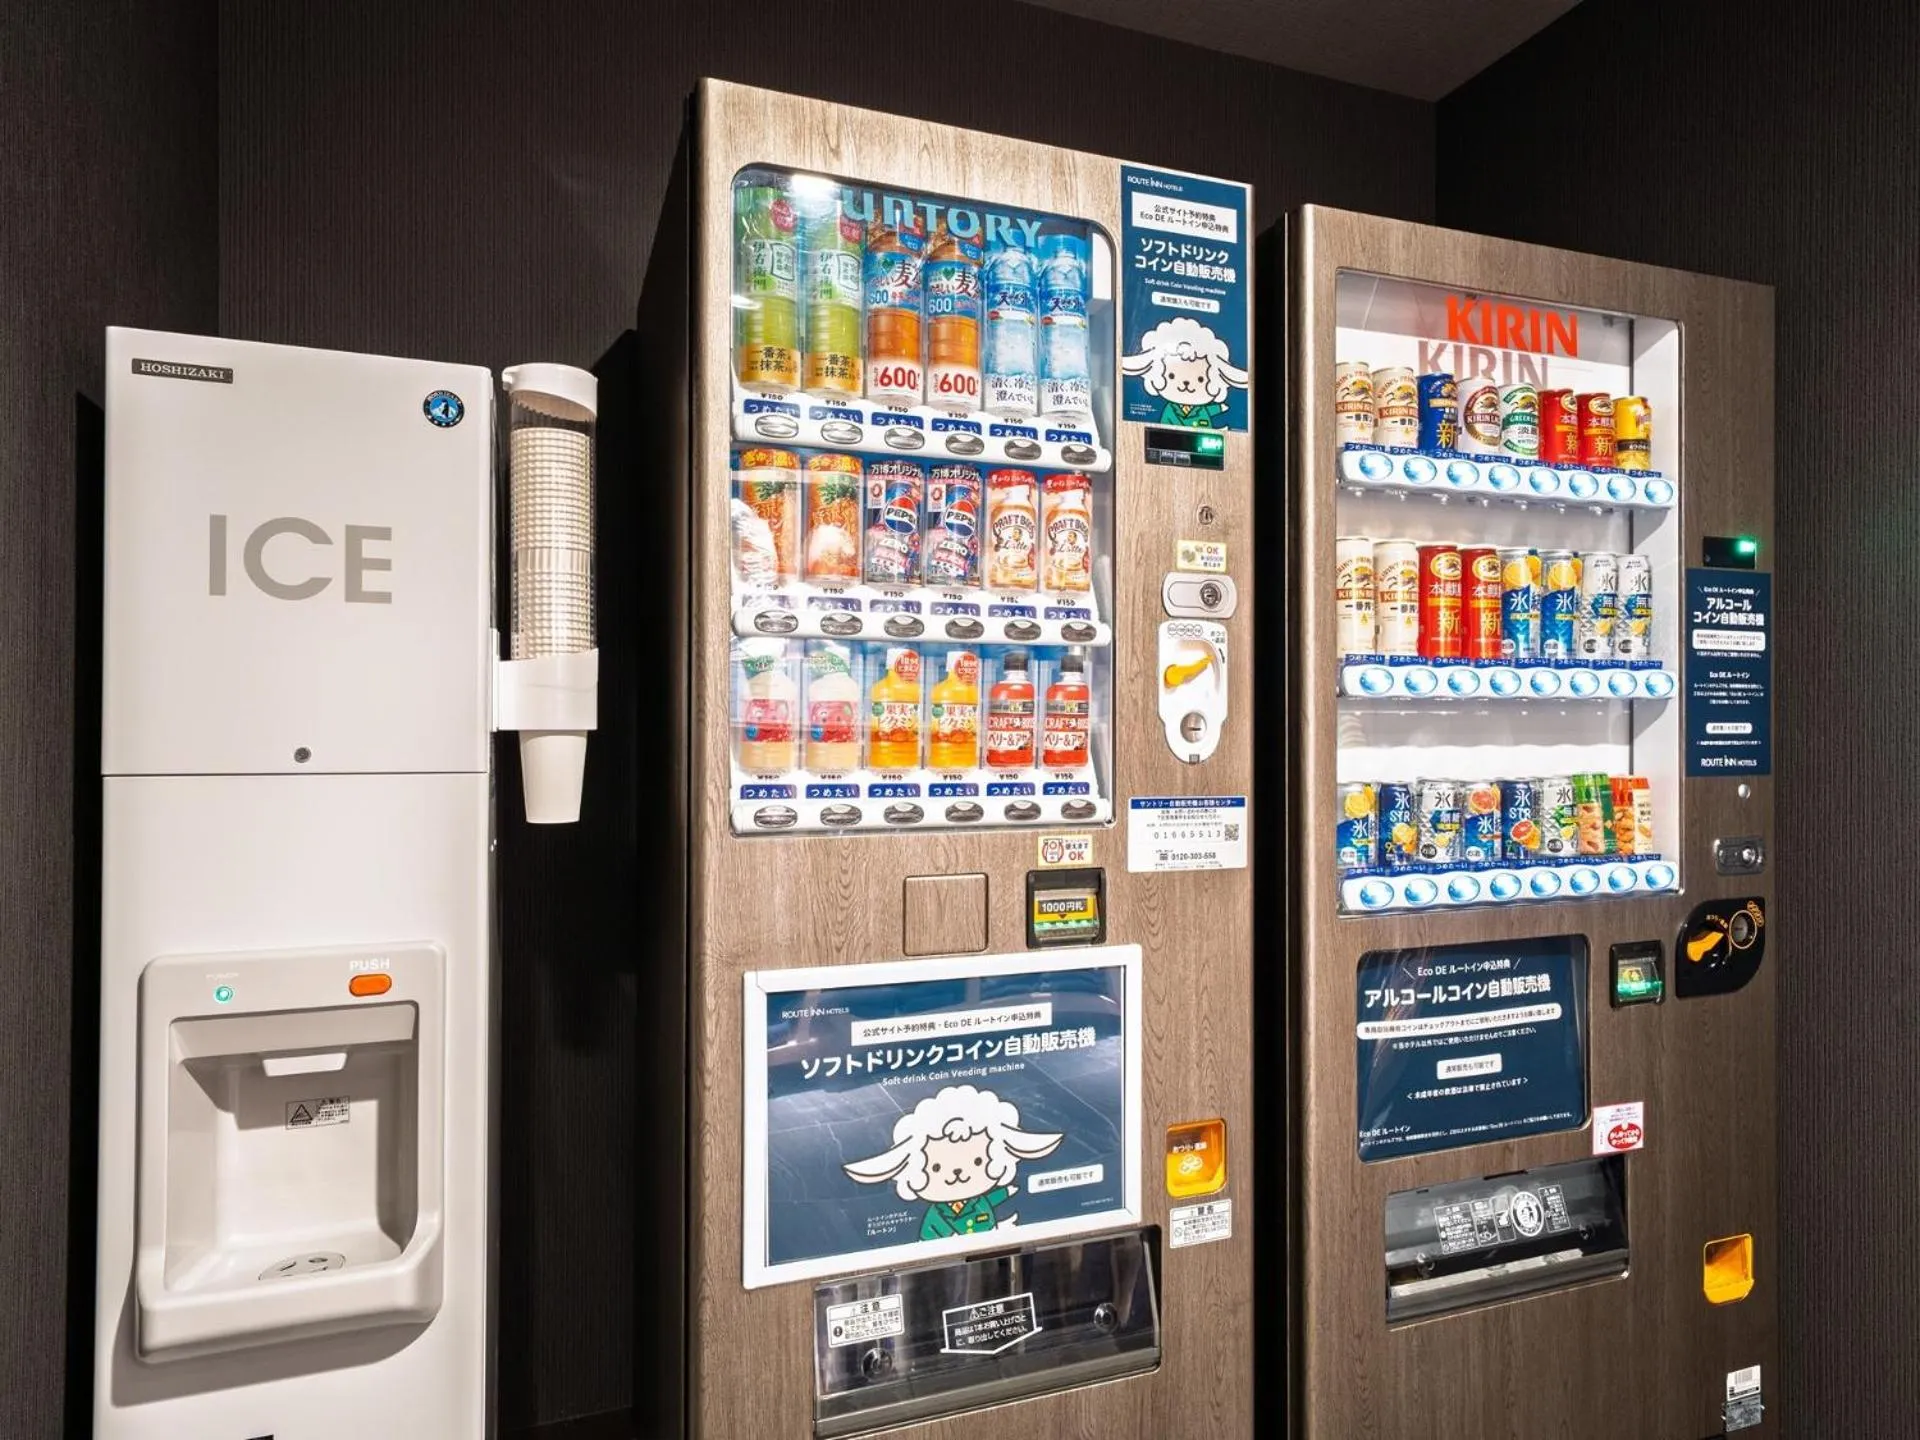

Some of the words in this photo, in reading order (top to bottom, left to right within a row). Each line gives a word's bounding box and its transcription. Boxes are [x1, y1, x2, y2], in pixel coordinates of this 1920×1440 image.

[841, 188, 1043, 248] UNTORY
[1155, 213, 1166, 223] DE
[1141, 237, 1230, 265] ソフトドリンク
[1134, 254, 1237, 284] コイン自動販売機
[1444, 294, 1579, 358] KIRIN
[140, 361, 226, 380] HOSHIZAKI
[879, 366, 917, 391] 600
[939, 373, 977, 397] 600
[749, 403, 796, 416] つめたい
[814, 410, 860, 422] つめたい
[876, 416, 920, 428] つめたい
[936, 422, 979, 434] つめたい
[992, 428, 1035, 439] つめたい
[1049, 433, 1089, 443] つめたい
[1595, 435, 1613, 457] 新
[208, 513, 393, 605] ICE
[1706, 597, 1753, 612] アルコール
[1693, 610, 1765, 627] コイン自動販売機
[745, 788, 793, 799] つめたい
[811, 788, 856, 798] つめたい
[872, 787, 916, 798] つめたい
[933, 787, 976, 796] つめたい
[991, 786, 1032, 796] つめたい
[1047, 785, 1086, 795] つめたい
[1068, 851, 1085, 861] OK
[1041, 901, 1084, 913] 1000円札
[349, 958, 390, 971] PUSH
[1417, 966, 1434, 977] Eco
[1435, 965, 1447, 975] DE
[1449, 958, 1511, 974] ルートイン申込特典
[1364, 973, 1551, 1008] アルコールコイン自動販売機
[782, 1007, 809, 1019] ROUTE
[961, 1017, 973, 1027] DE
[974, 1011, 1042, 1026] ルートイン申込特典
[801, 1026, 1097, 1080] ソフトドリンクコイン自動販売機
[882, 1076, 901, 1087] Soft
[902, 1074, 926, 1084] drink
[928, 1072, 949, 1081] Coin
[951, 1065, 987, 1078] Vending
[989, 1062, 1025, 1074] machine
